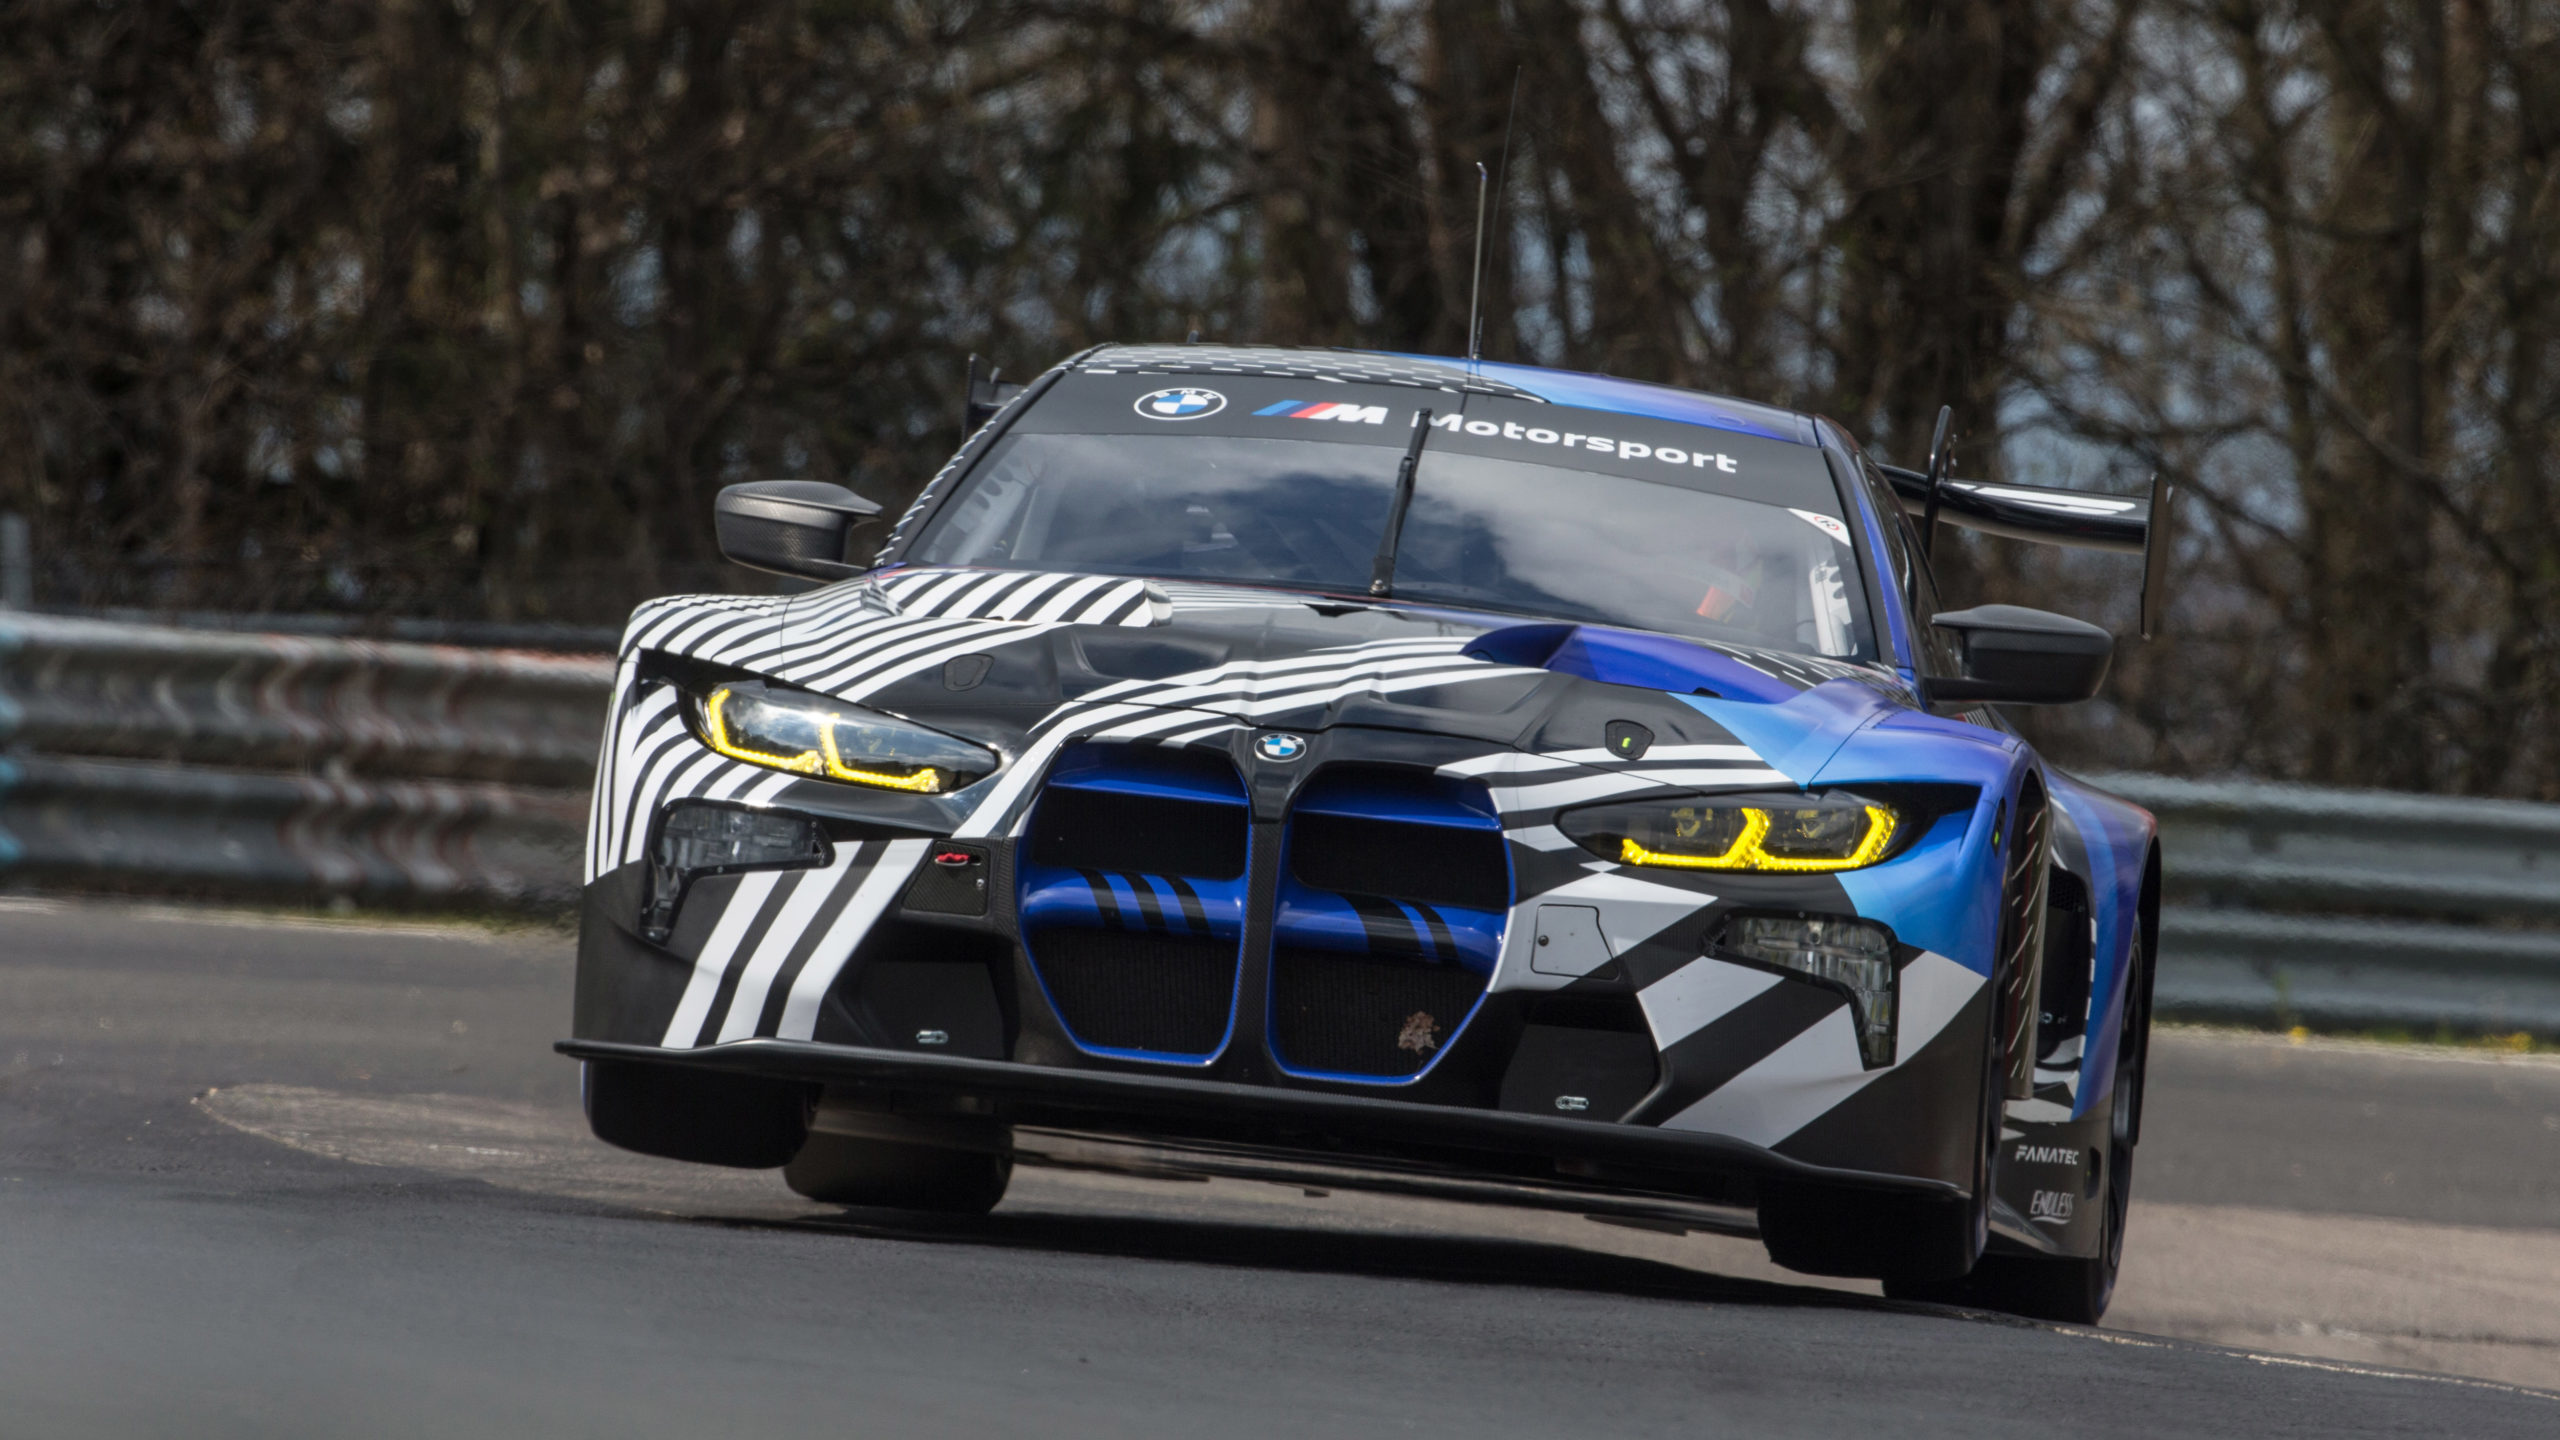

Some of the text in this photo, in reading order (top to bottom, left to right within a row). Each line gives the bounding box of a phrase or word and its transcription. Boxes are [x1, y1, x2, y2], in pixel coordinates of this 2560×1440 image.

[1411, 411, 1738, 473] Motorsport
[2016, 1144, 2079, 1165] FANATEC
[2030, 1190, 2074, 1217] ENDLESS
